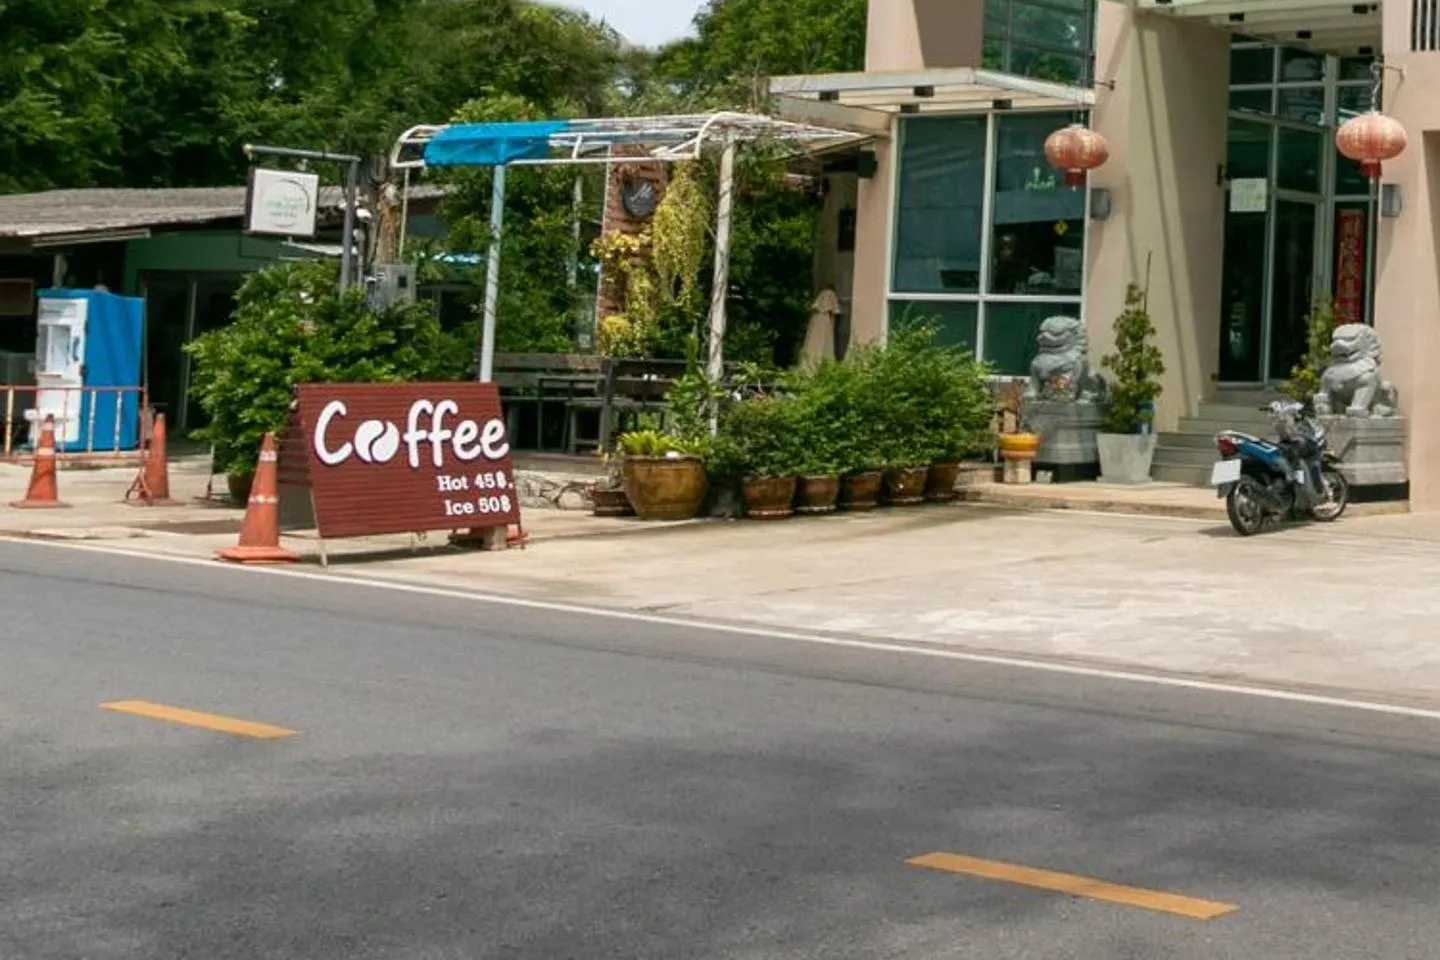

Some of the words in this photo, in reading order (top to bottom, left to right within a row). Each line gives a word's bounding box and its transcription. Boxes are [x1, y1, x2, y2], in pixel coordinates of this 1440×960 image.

[314, 399, 510, 468] Coffee
[437, 475, 469, 491] Hot
[444, 499, 474, 516] Ice
